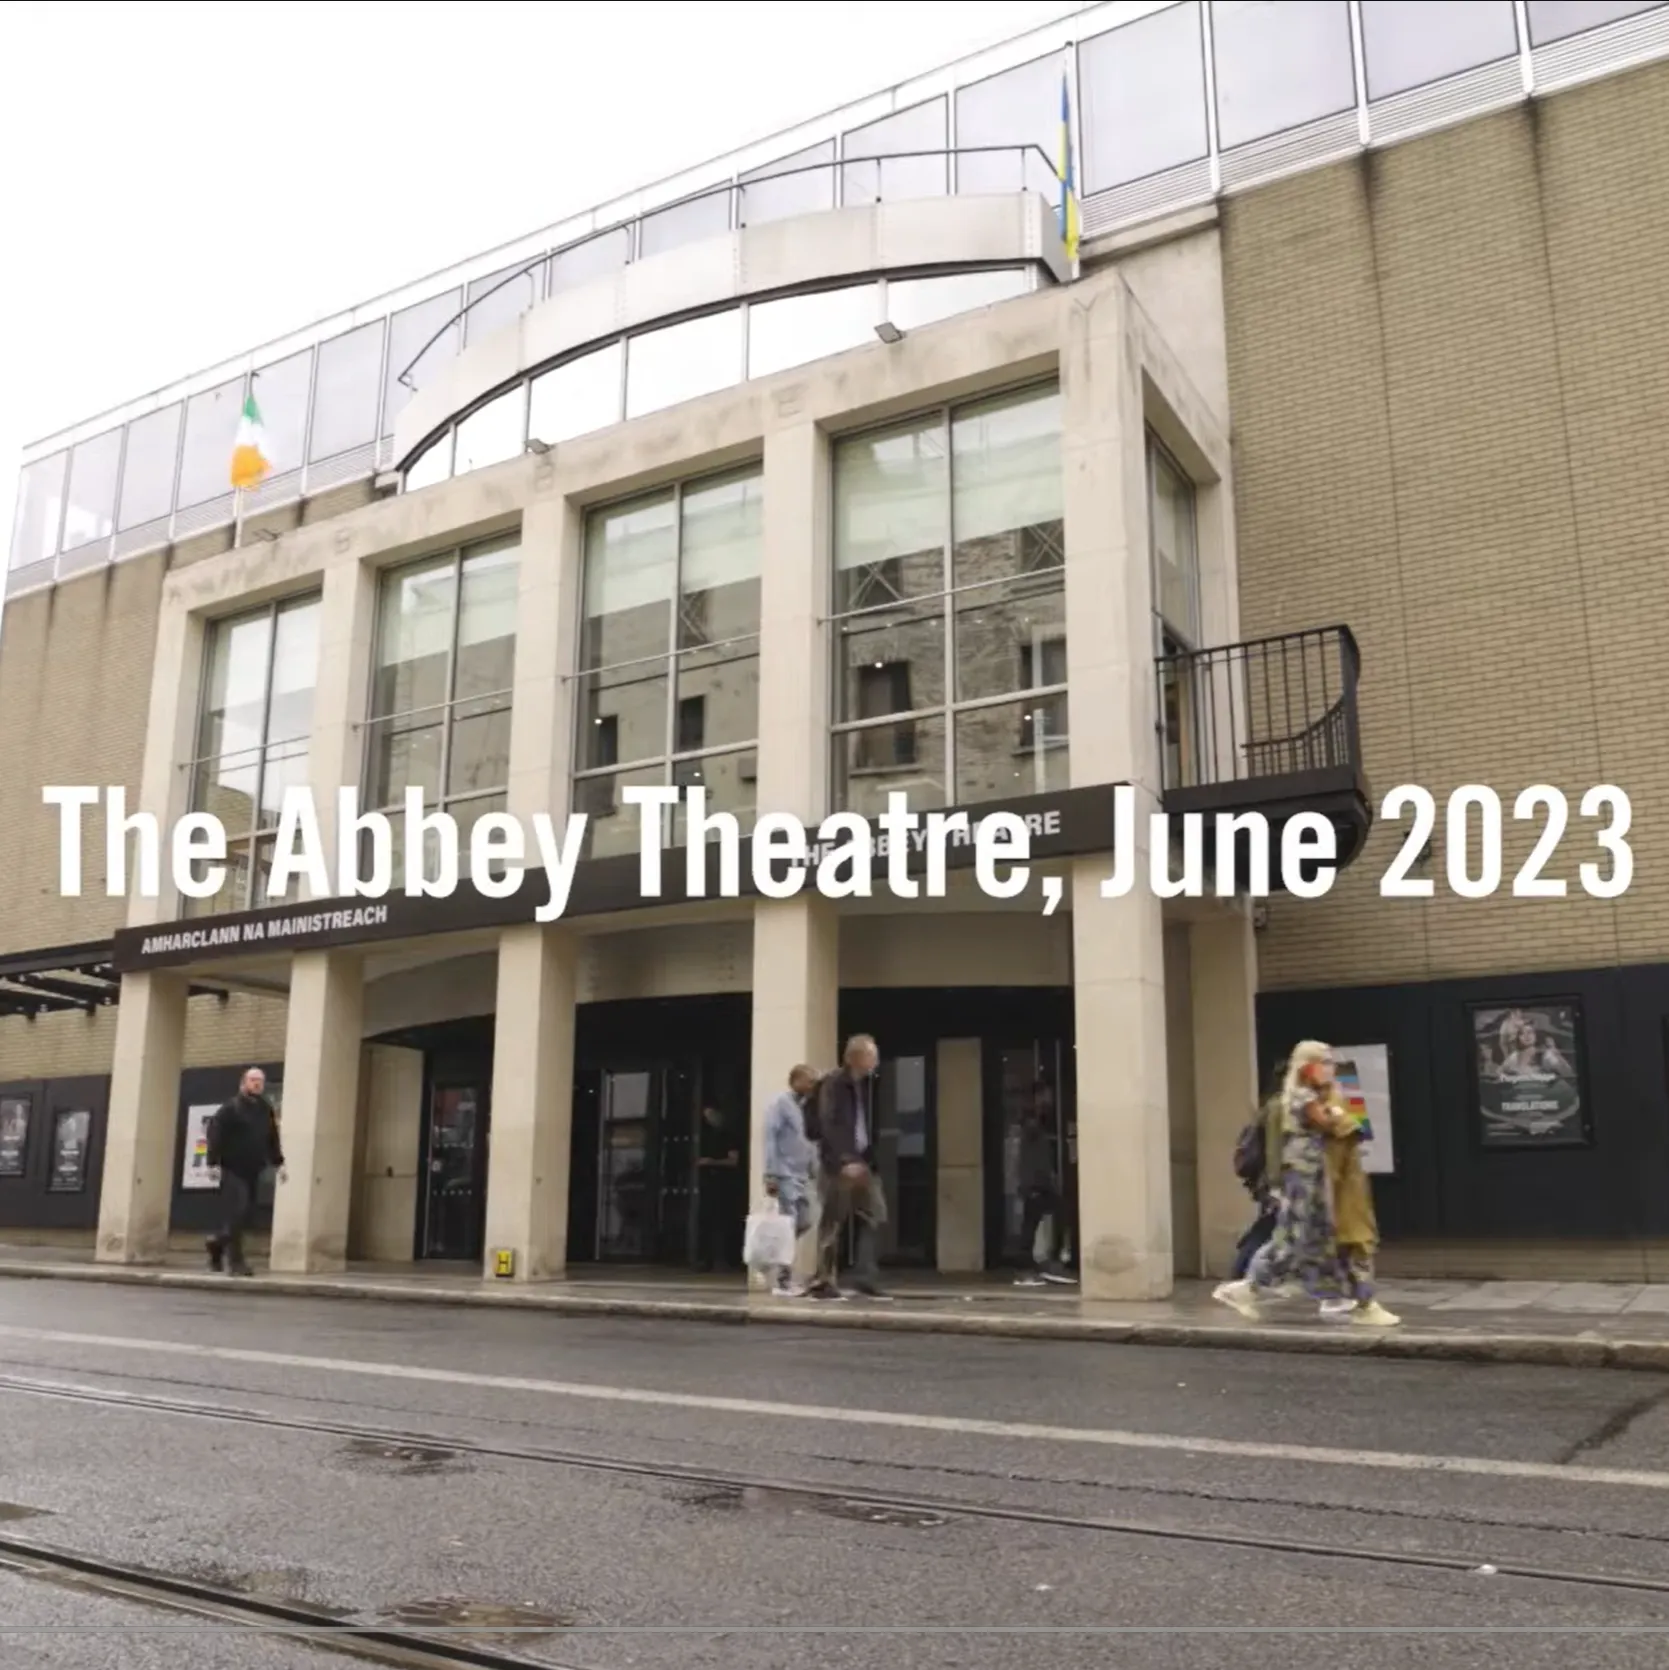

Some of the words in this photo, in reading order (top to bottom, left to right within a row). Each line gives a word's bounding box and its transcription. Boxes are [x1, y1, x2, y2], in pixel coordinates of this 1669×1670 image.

[141, 925, 241, 954] AMHARCLANN
[243, 921, 265, 941] NA
[267, 904, 388, 939] MAINISTREACH
